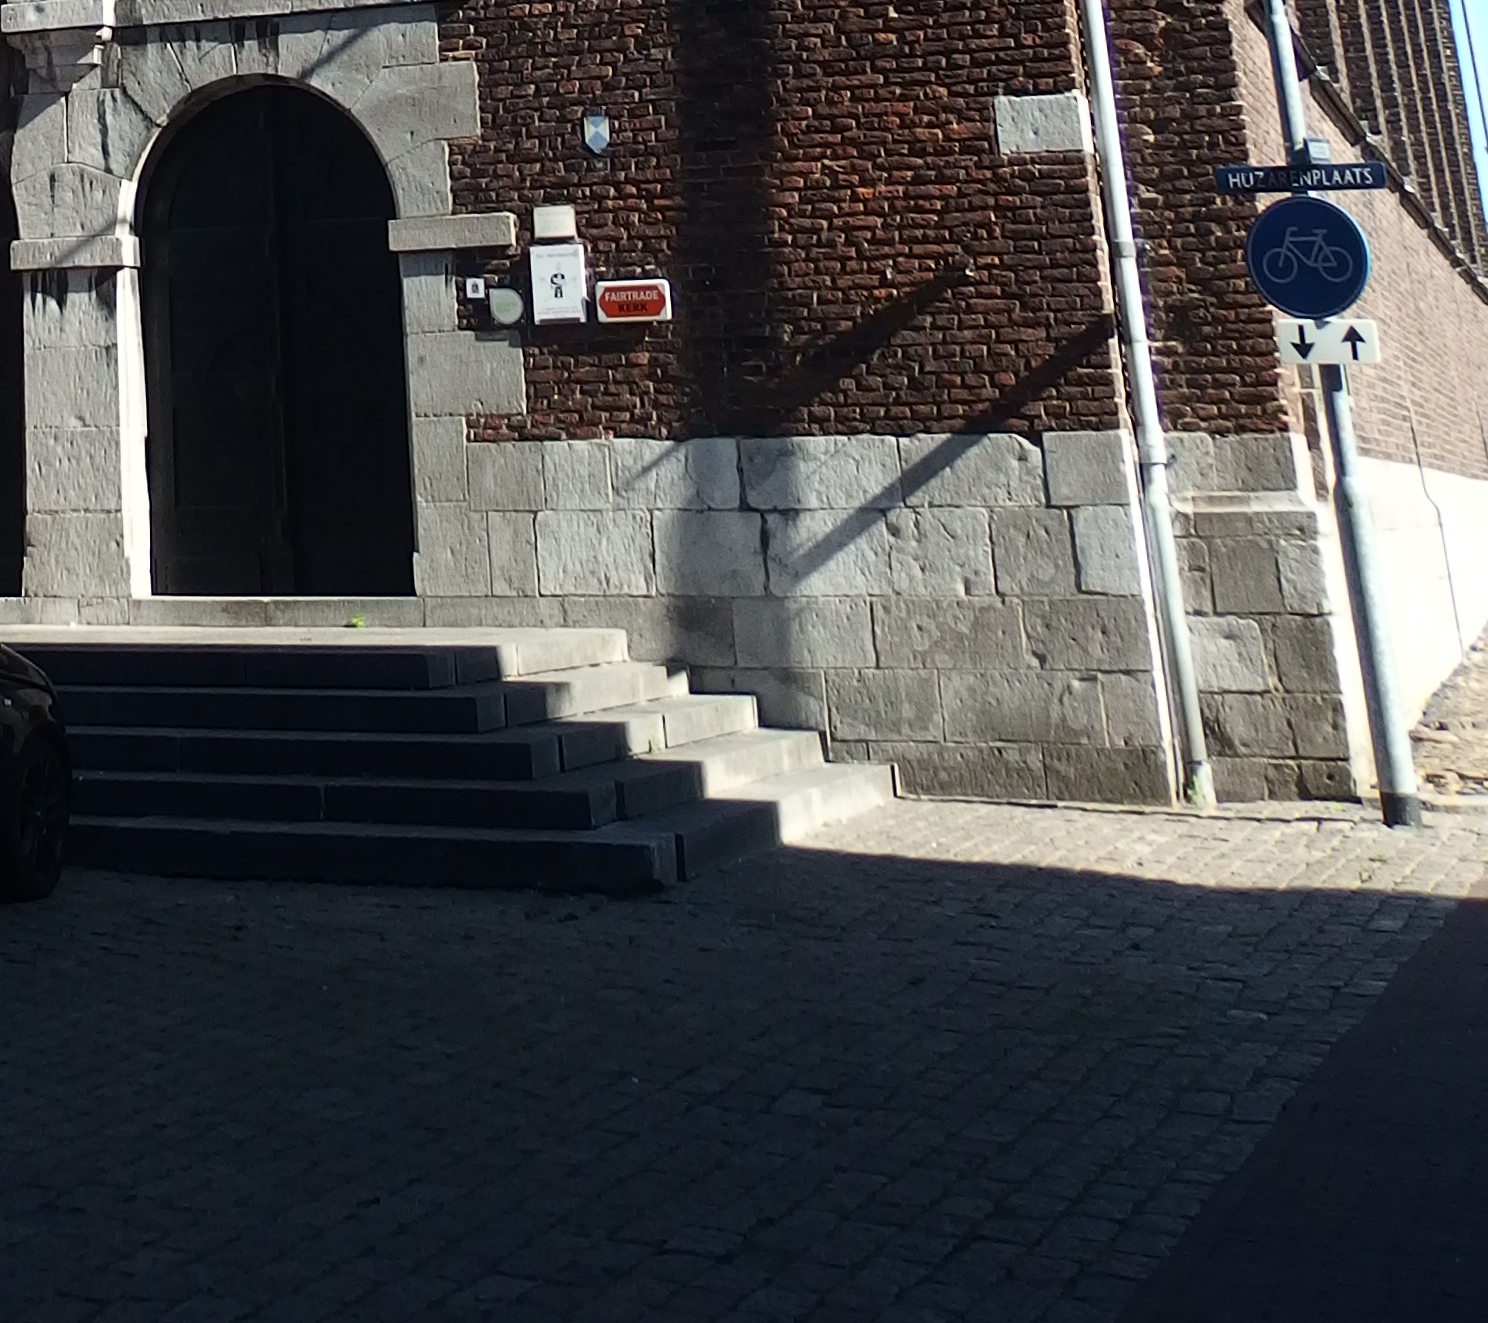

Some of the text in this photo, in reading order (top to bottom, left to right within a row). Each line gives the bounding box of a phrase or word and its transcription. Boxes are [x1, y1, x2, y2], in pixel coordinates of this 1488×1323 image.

[1228, 167, 1374, 189] HUZARENPLAATS
[605, 290, 659, 302] FAIRTRADE
[618, 302, 648, 313] KERK
